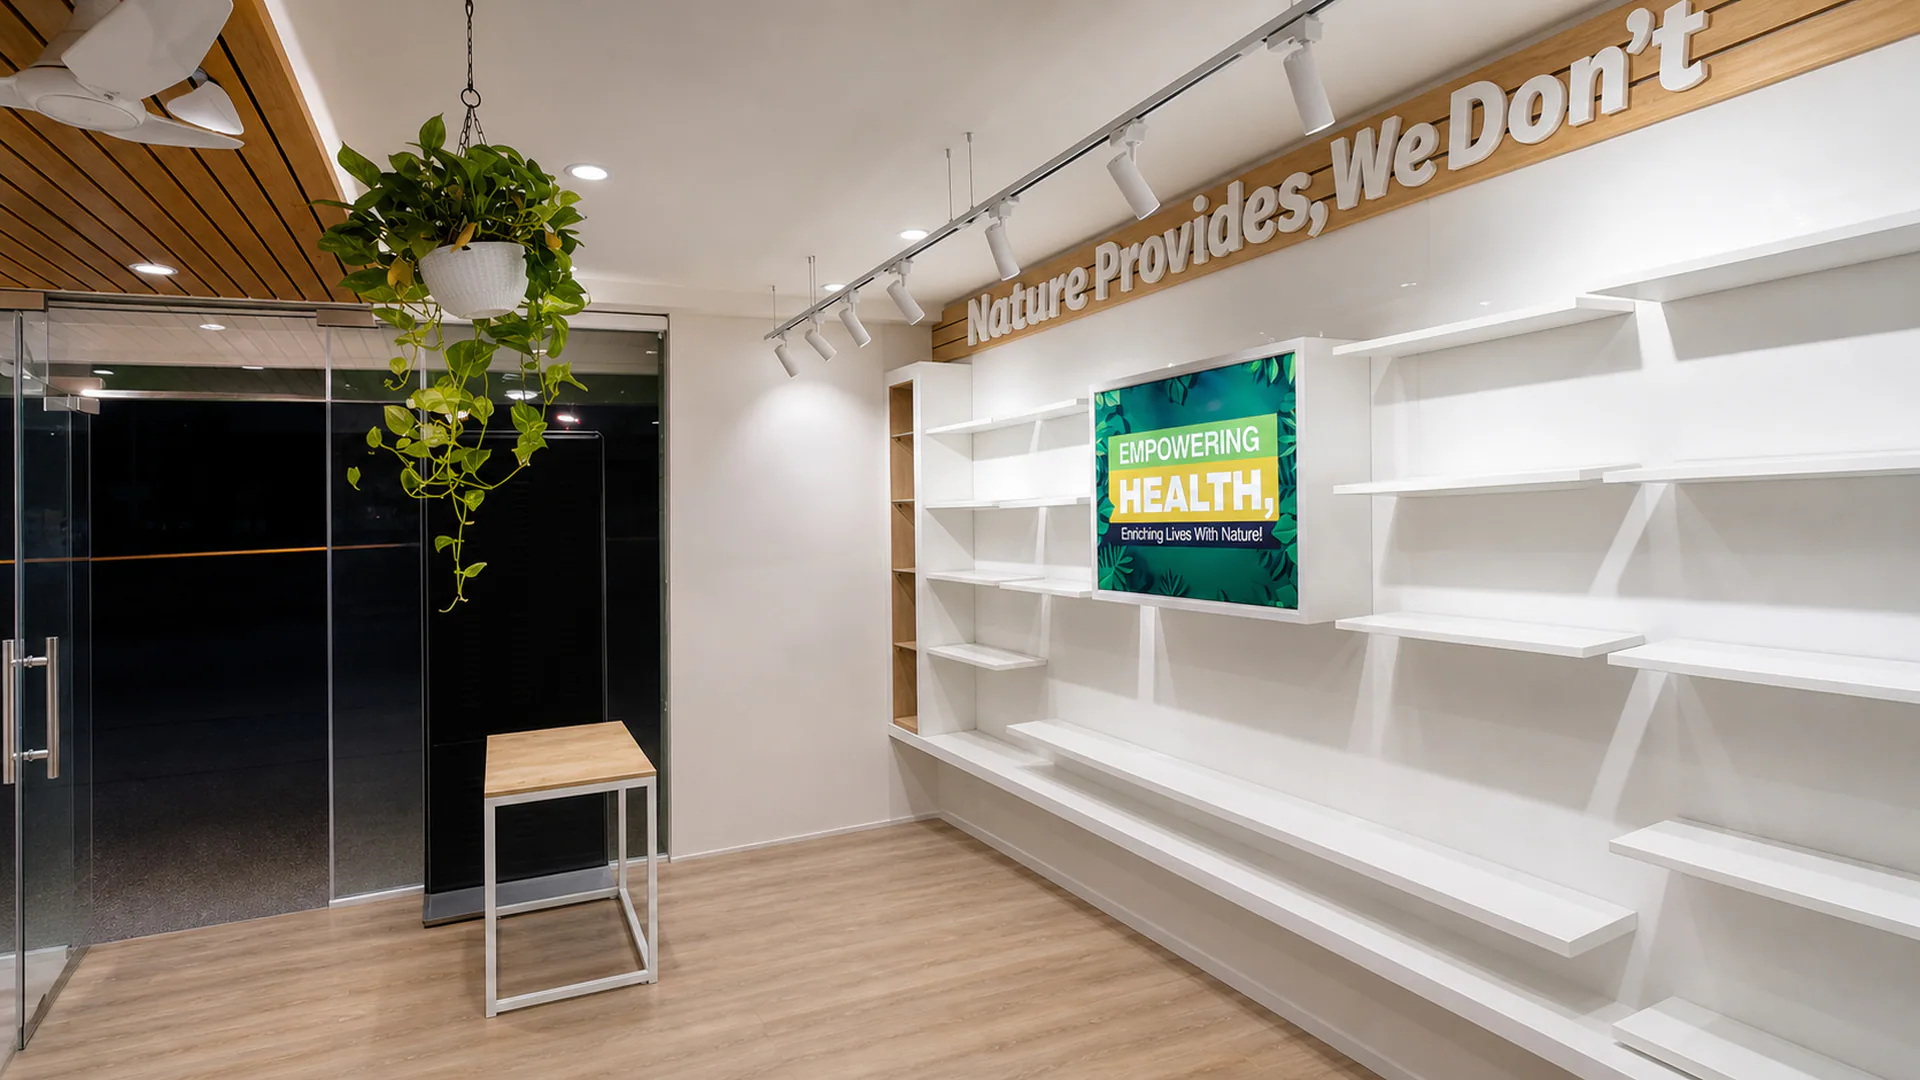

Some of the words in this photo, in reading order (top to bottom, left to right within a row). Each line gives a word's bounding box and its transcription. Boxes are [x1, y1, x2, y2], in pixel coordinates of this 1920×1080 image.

[967, 266, 1089, 346] Nature
[1095, 173, 1329, 301] Provides,
[1330, 115, 1440, 211] We
[1448, 0, 1710, 171] Don't
[1119, 426, 1260, 465] EMPOWERING
[1119, 469, 1274, 519] HEALTH,
[1121, 527, 1164, 544] Enriching
[1165, 527, 1192, 542] Lives
[1194, 527, 1218, 541] With
[1221, 526, 1263, 542] Nature!
